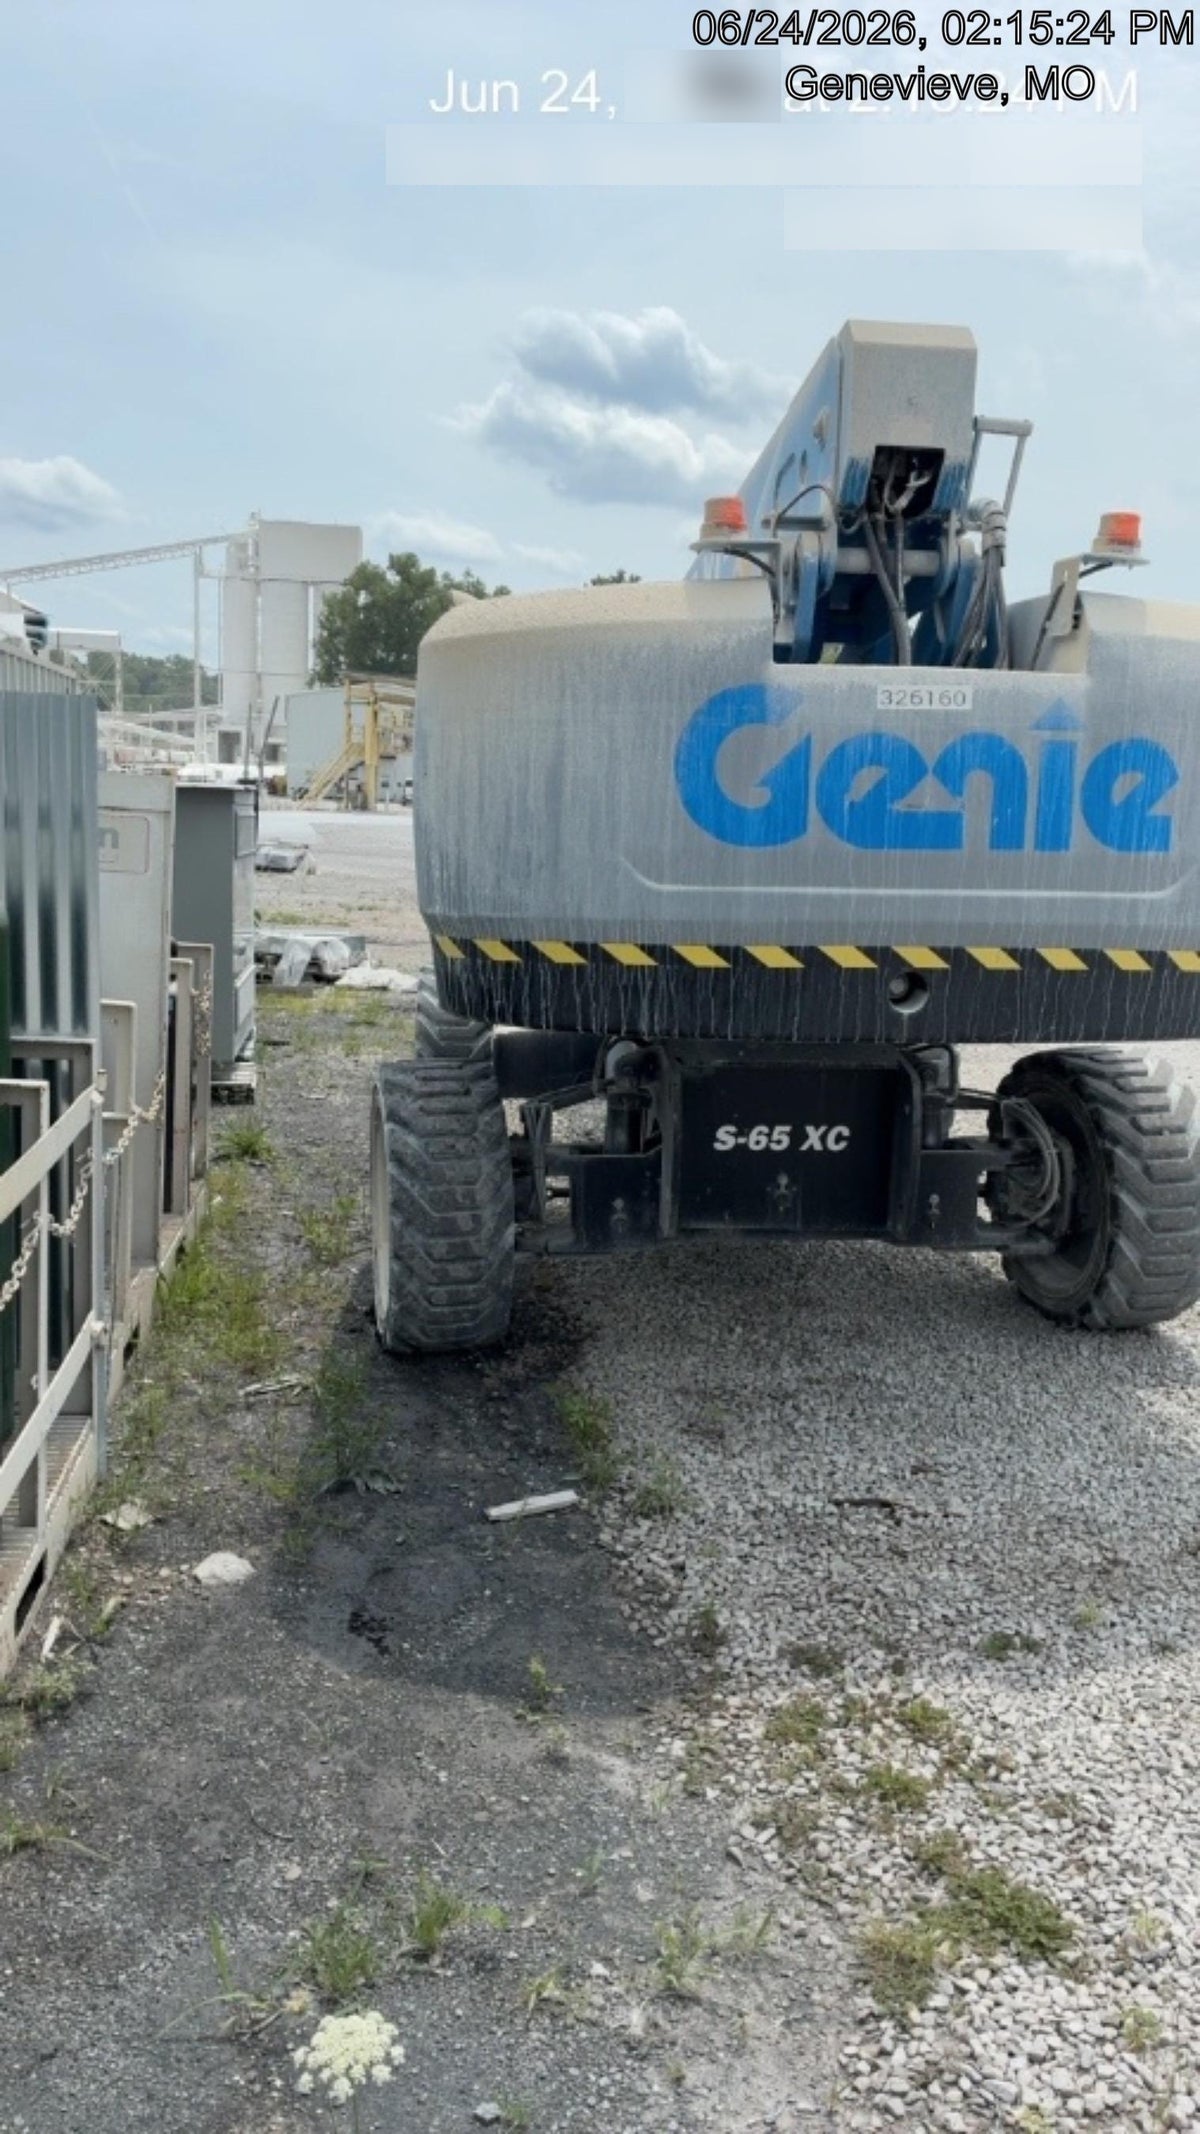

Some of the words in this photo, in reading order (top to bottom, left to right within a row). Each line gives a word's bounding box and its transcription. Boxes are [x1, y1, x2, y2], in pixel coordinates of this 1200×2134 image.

[879, 689, 967, 708] 326160
[673, 682, 1181, 855] Genie
[713, 1125, 792, 1151] S-65
[799, 1125, 851, 1151] XC
